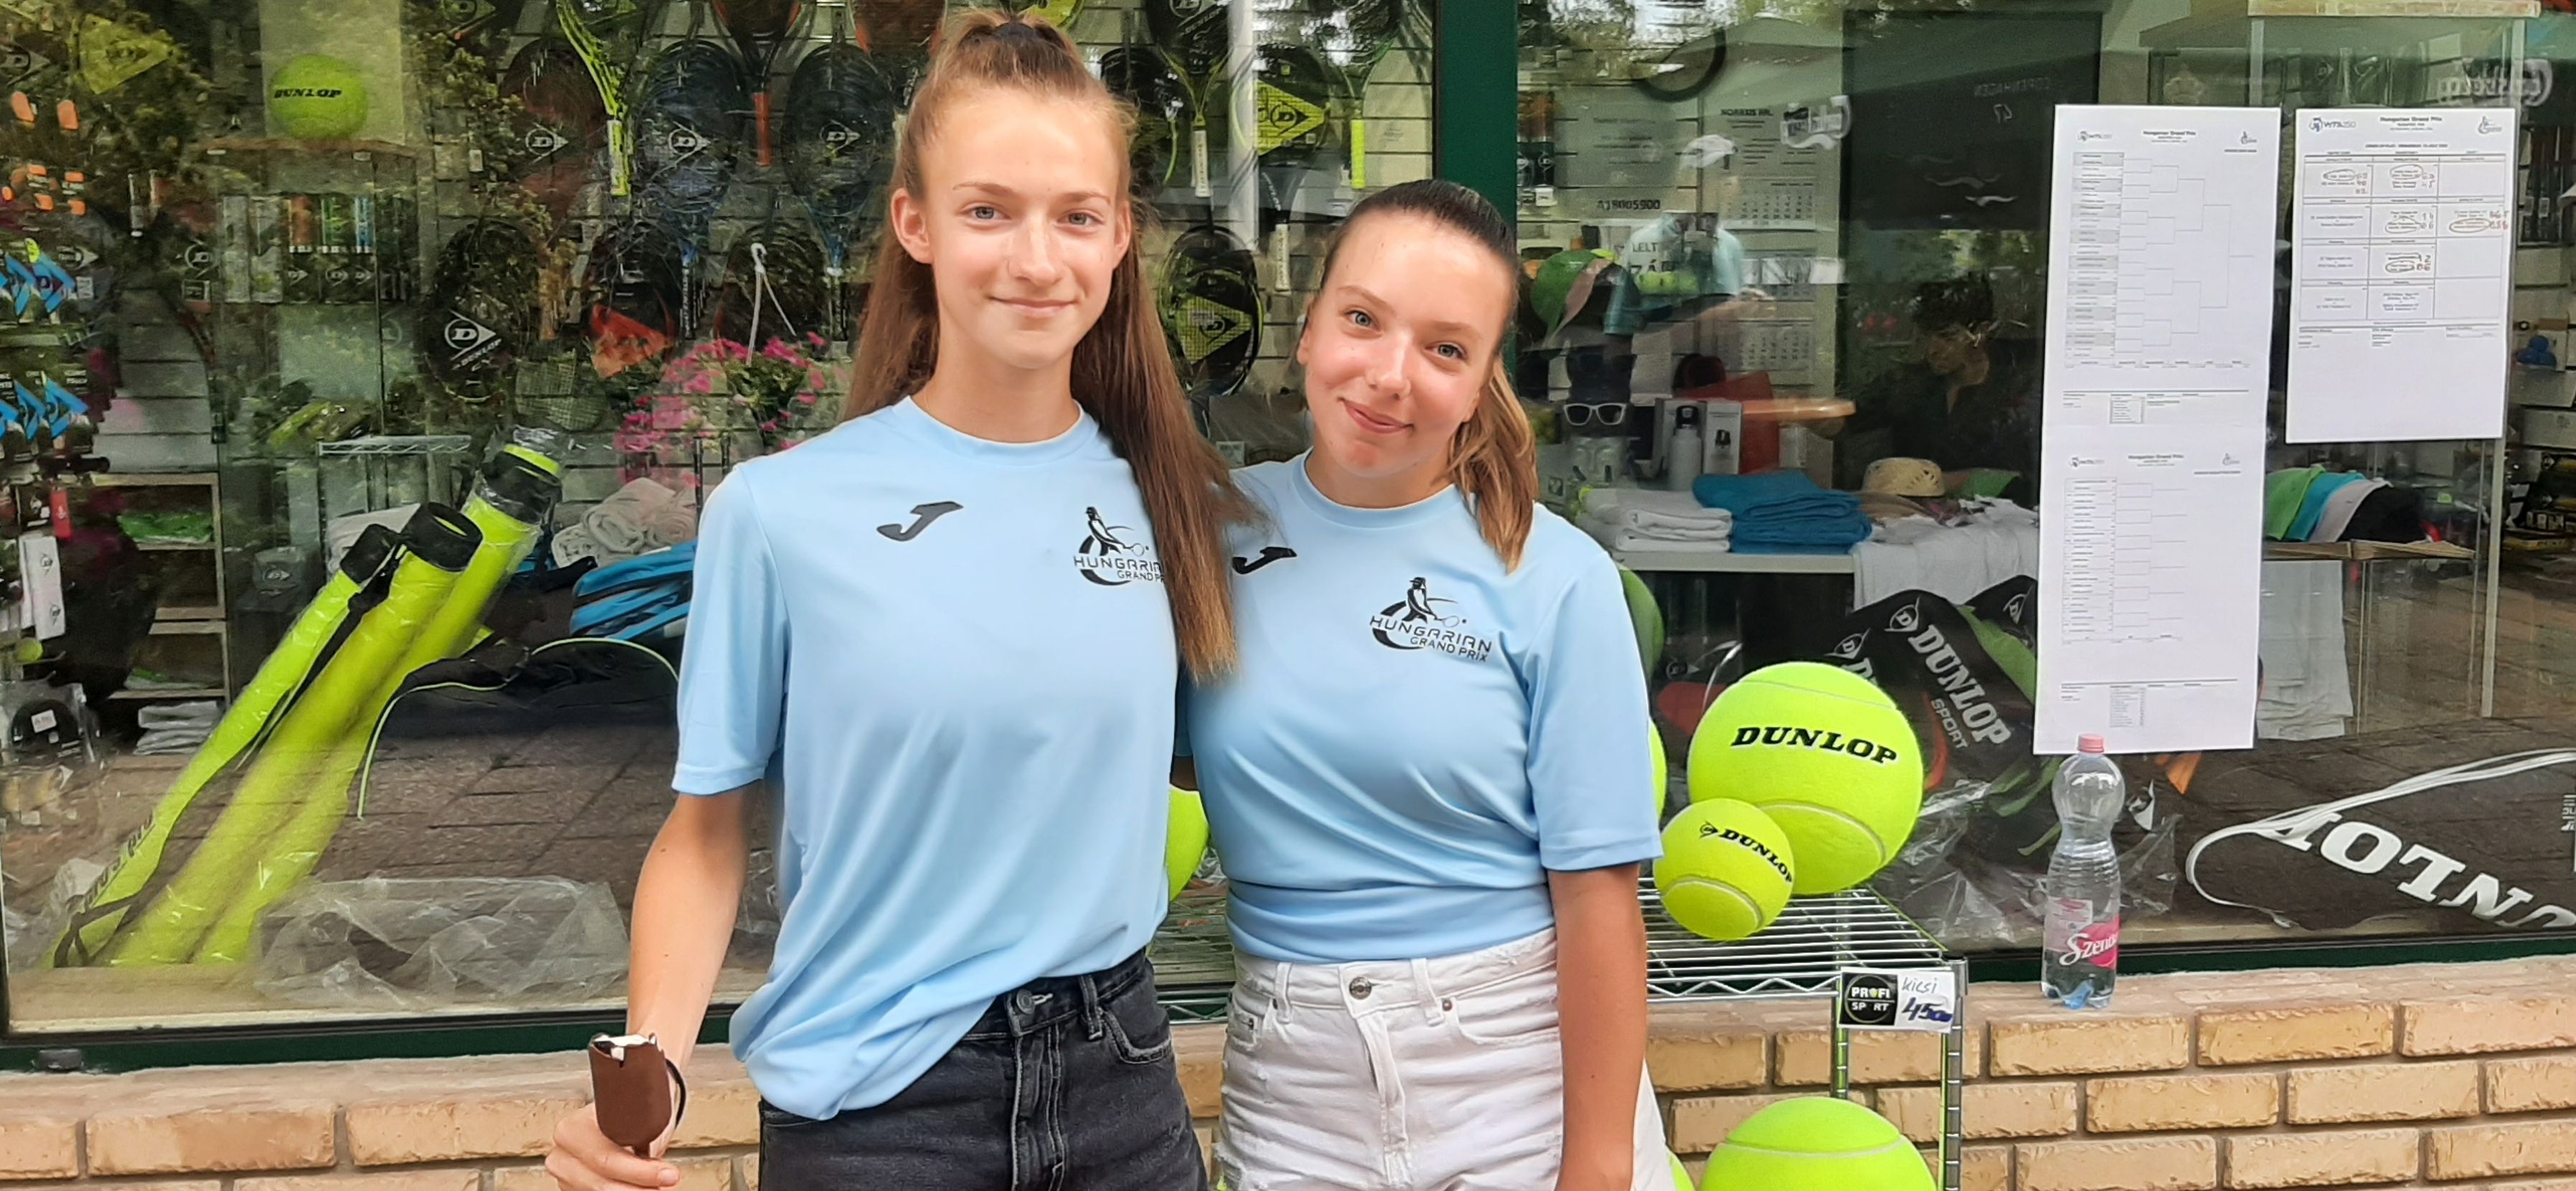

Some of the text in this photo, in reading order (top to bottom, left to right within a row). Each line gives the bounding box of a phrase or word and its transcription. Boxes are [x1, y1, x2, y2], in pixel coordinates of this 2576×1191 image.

[274, 88, 342, 99] DUNLOP
[451, 338, 502, 370] DUNLOP
[1073, 556, 1164, 574] HUNGARIA
[1117, 570, 1153, 581] GRAND
[1369, 608, 1492, 653] HUNGARIAN
[1410, 636, 1488, 662] GRAND PRIX
[1907, 624, 2011, 744] DUNLOP
[1931, 698, 1969, 749] SPORT
[1730, 727, 1897, 764] DUNLOP
[1718, 828, 1793, 882] DUNLOP
[1851, 1002, 1891, 1011] SPRT
